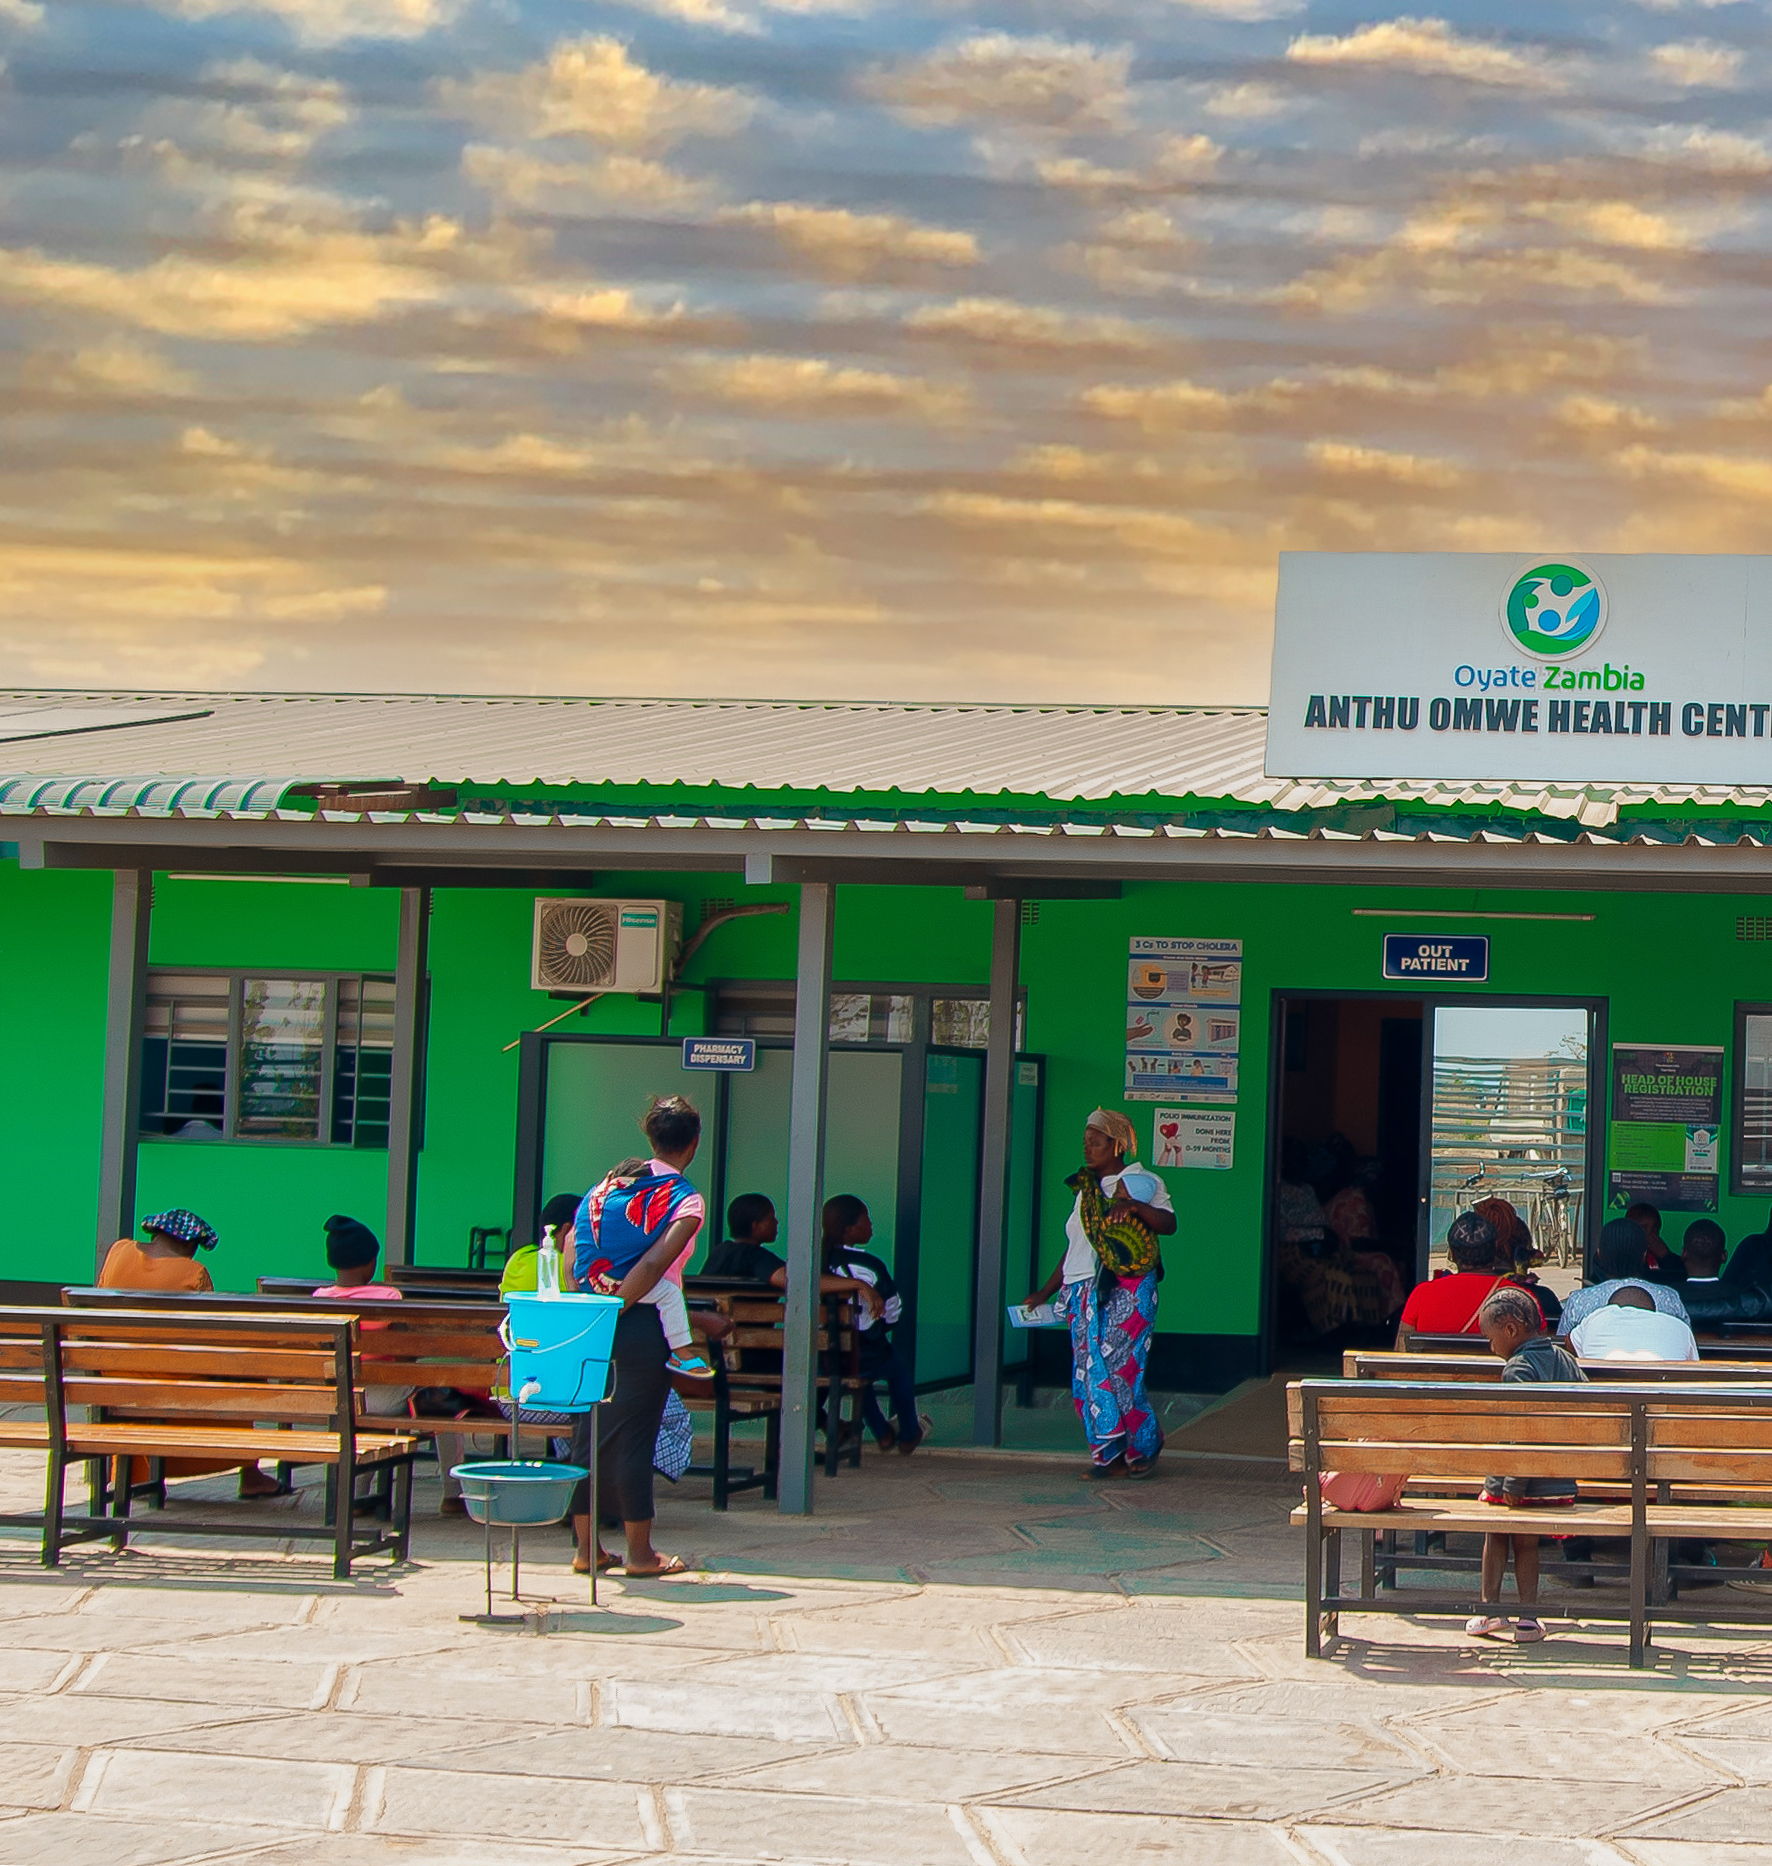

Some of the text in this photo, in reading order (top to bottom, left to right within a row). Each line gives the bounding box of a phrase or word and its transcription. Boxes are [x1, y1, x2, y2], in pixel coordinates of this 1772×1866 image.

[1454, 662, 1645, 692] Oyate Zambia
[1303, 694, 1420, 731] ANTHU
[1428, 697, 1539, 734] OMWE
[1548, 699, 1672, 736] HEALTH
[1135, 940, 1141, 949] 3
[1155, 940, 1169, 949] TO
[1170, 941, 1195, 950] STOP
[1196, 942, 1238, 951] CHOLERA
[1417, 944, 1454, 958] OUT
[1400, 957, 1470, 972] PATIENT
[693, 1044, 744, 1055] PHARMACY
[690, 1054, 747, 1065] DISPENSARY
[1621, 1073, 1717, 1087] HEAD OF HOUSE
[1623, 1084, 1714, 1097] REGISTRATION
[1180, 1113, 1232, 1122] IMMUNIZATION
[1210, 1137, 1231, 1145] FROM
